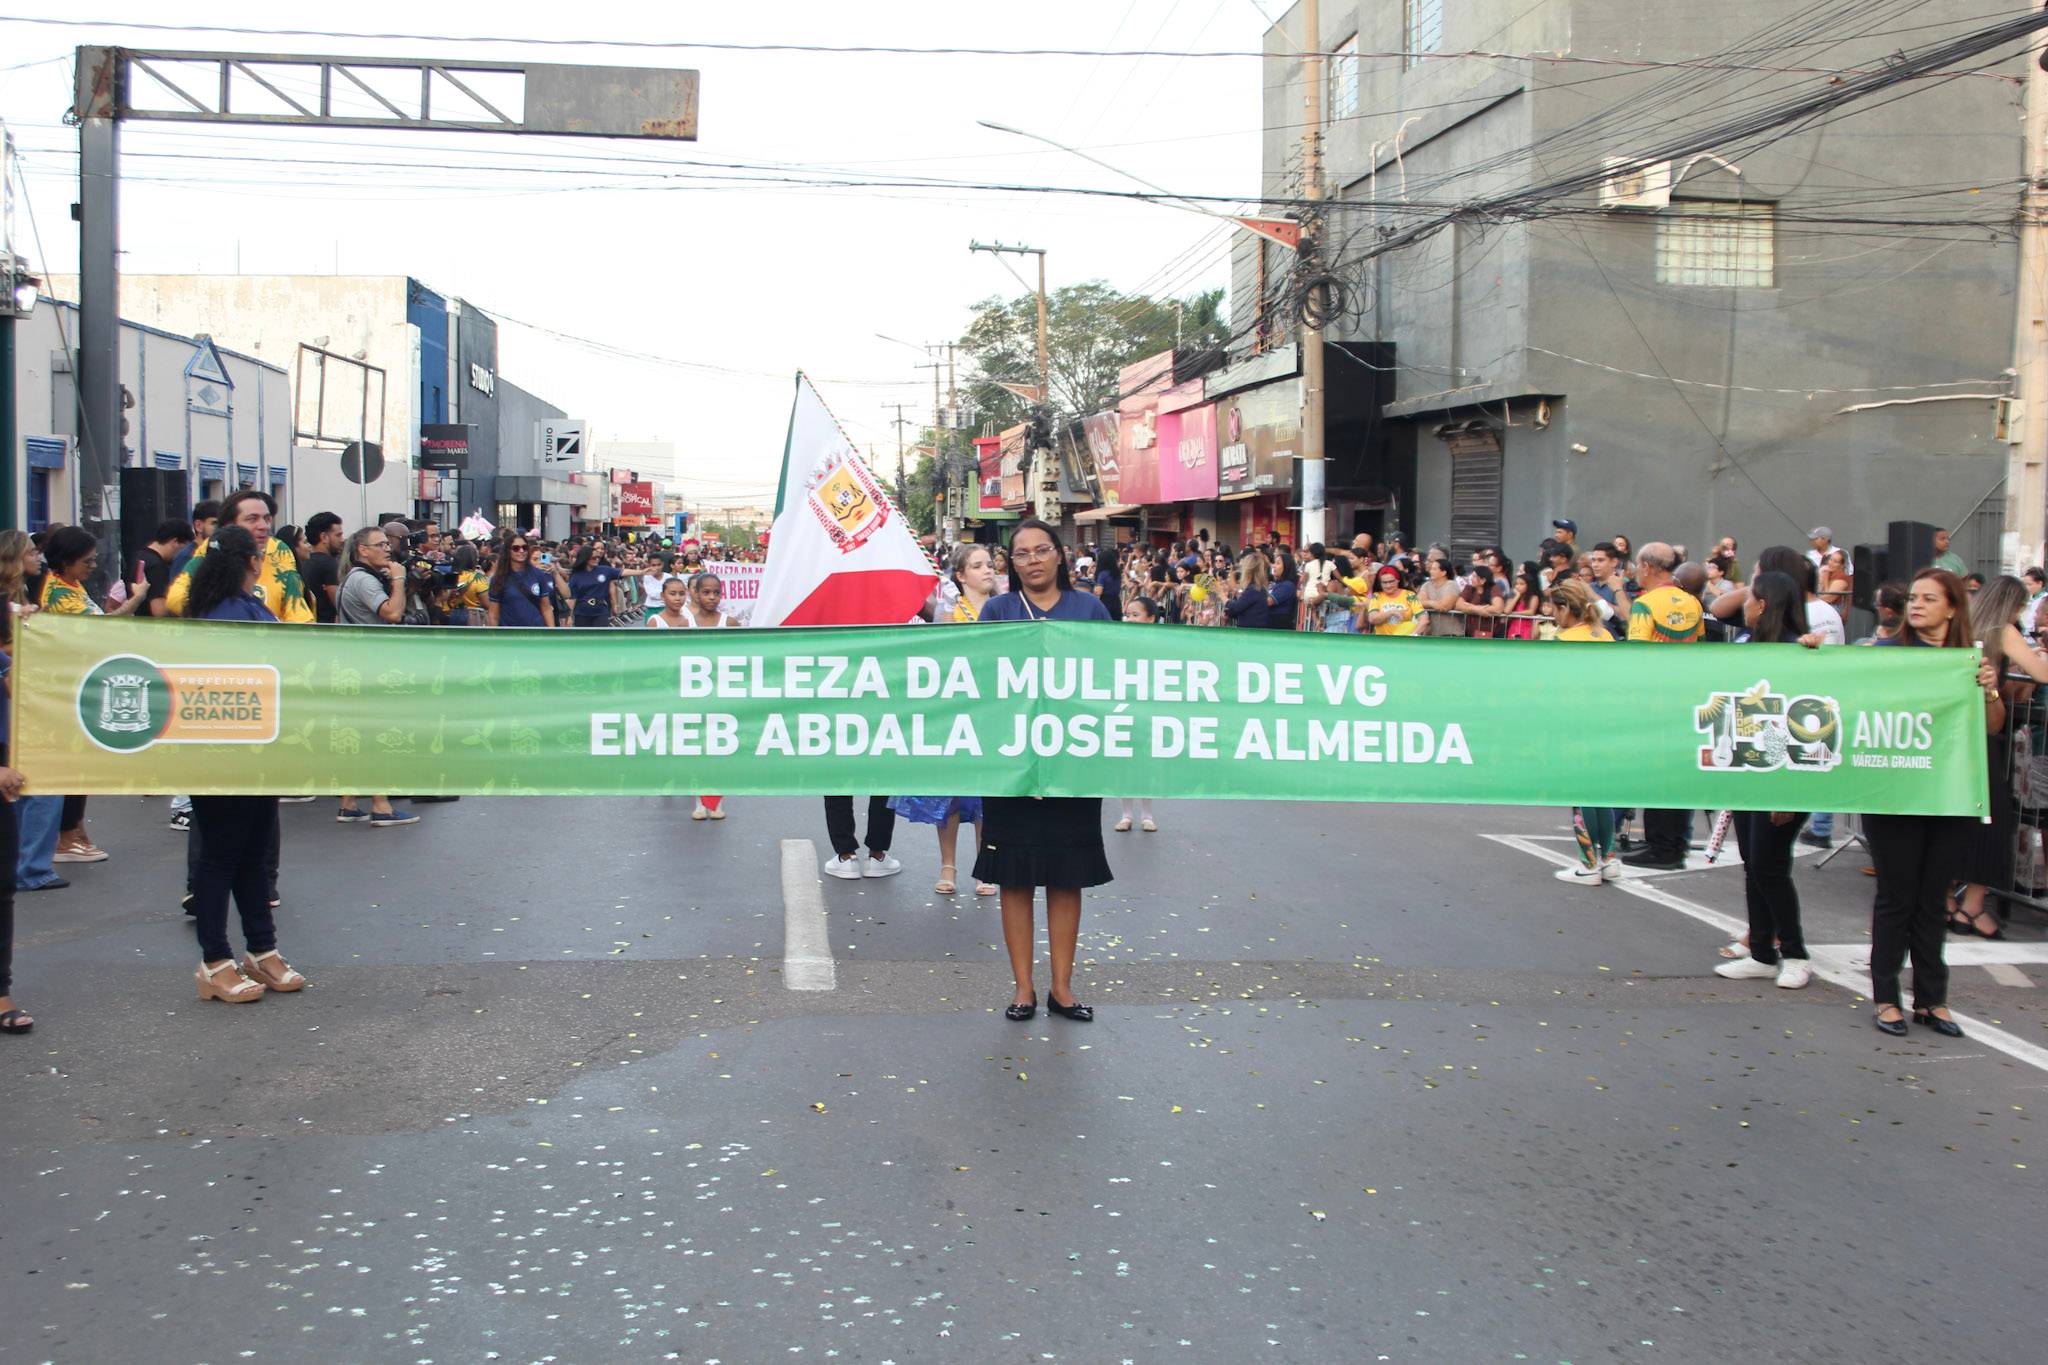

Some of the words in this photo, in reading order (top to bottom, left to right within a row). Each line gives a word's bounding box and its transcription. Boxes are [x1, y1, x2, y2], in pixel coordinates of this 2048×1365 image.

[545, 427, 553, 463] STUDIO
[729, 580, 759, 599] BELEZ
[178, 676, 264, 685] PREFEITURA
[679, 656, 890, 698] BELEZA
[906, 656, 980, 699] DA
[997, 656, 1220, 702] MULHER
[1237, 662, 1304, 704] DE
[1315, 664, 1388, 707] VG
[180, 686, 262, 705] VÁRZEA
[179, 707, 262, 720] GRANDE
[590, 713, 740, 756] EMEB
[754, 713, 983, 756] ABDALA
[998, 703, 1134, 757] JOSÉ
[1150, 716, 1219, 759] DE
[1233, 718, 1474, 764] ALMEIDA
[1852, 711, 1933, 750] ANOS
[1852, 751, 1889, 768] VÁRZEA
[1891, 755, 1932, 769] GRANDE
